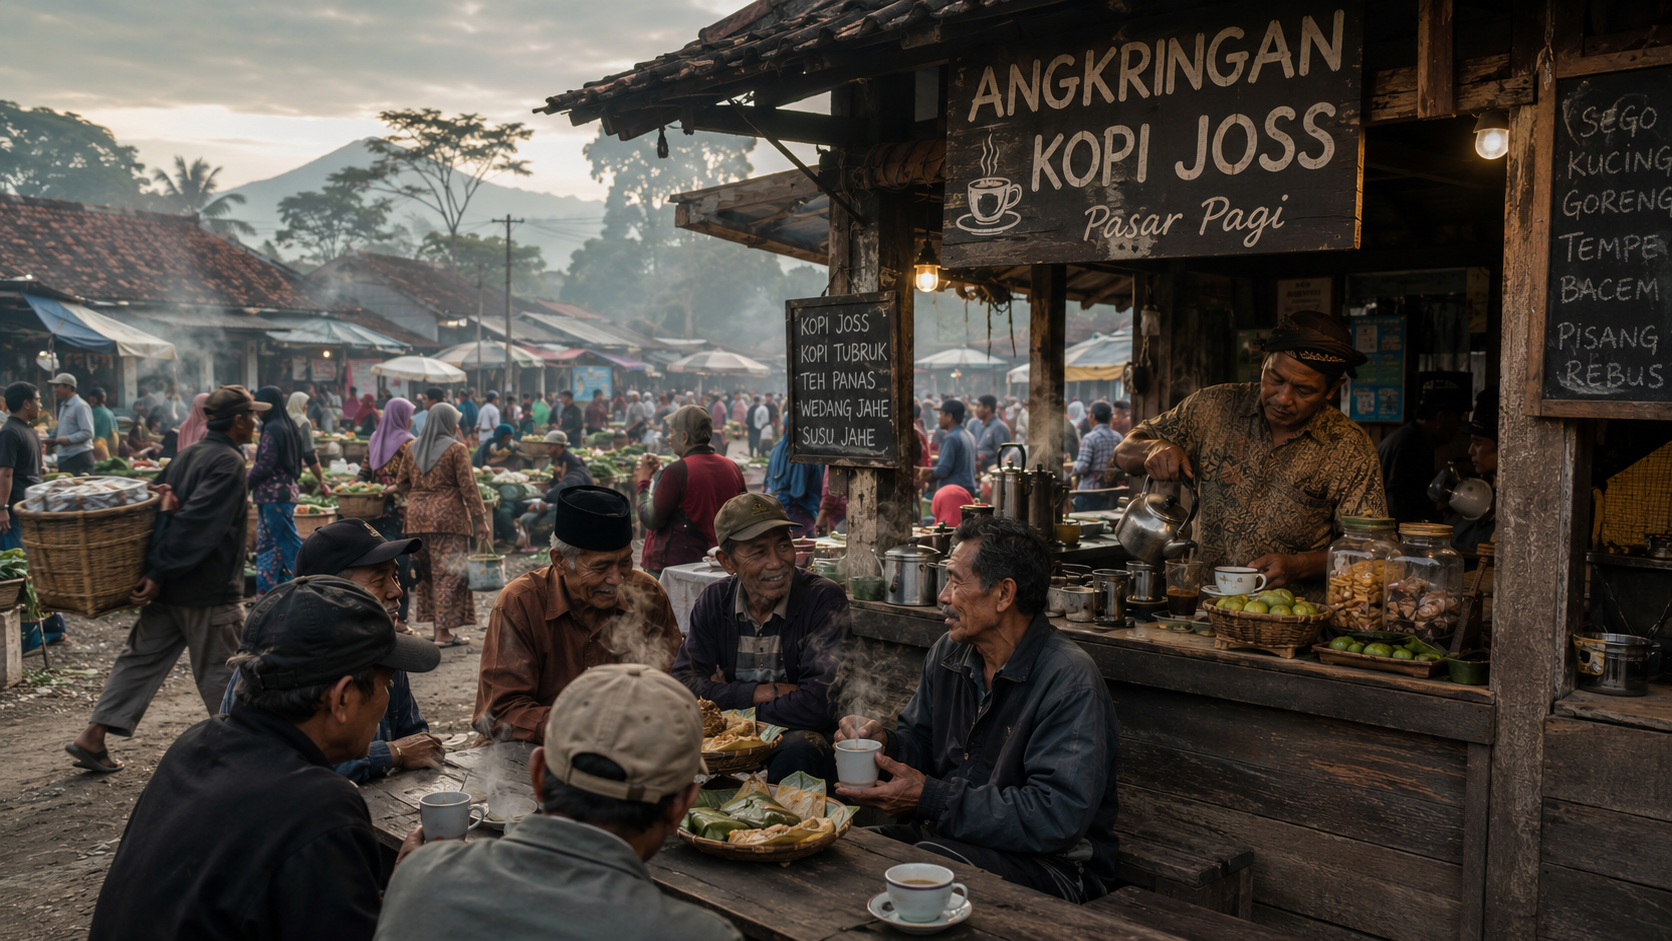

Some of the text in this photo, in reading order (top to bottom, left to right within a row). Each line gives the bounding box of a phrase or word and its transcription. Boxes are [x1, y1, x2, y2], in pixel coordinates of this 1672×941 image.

[967, 9, 1345, 123] ANGKRINGAN
[1031, 102, 1337, 193] KOPI JOSS
[1562, 186, 1672, 221] GORENG
[1083, 194, 1290, 248] Pasar Pagi
[1558, 231, 1659, 262] TEMPE
[1560, 275, 1659, 304] BACEM
[836, 313, 870, 334] JOSS
[801, 342, 888, 363] KOPI TUBRUK
[800, 370, 876, 390] TEH PANAS
[1565, 360, 1664, 389] REBUS
[800, 398, 889, 421] WEDANG JAHE
[802, 426, 876, 447] SUSU JAHE
